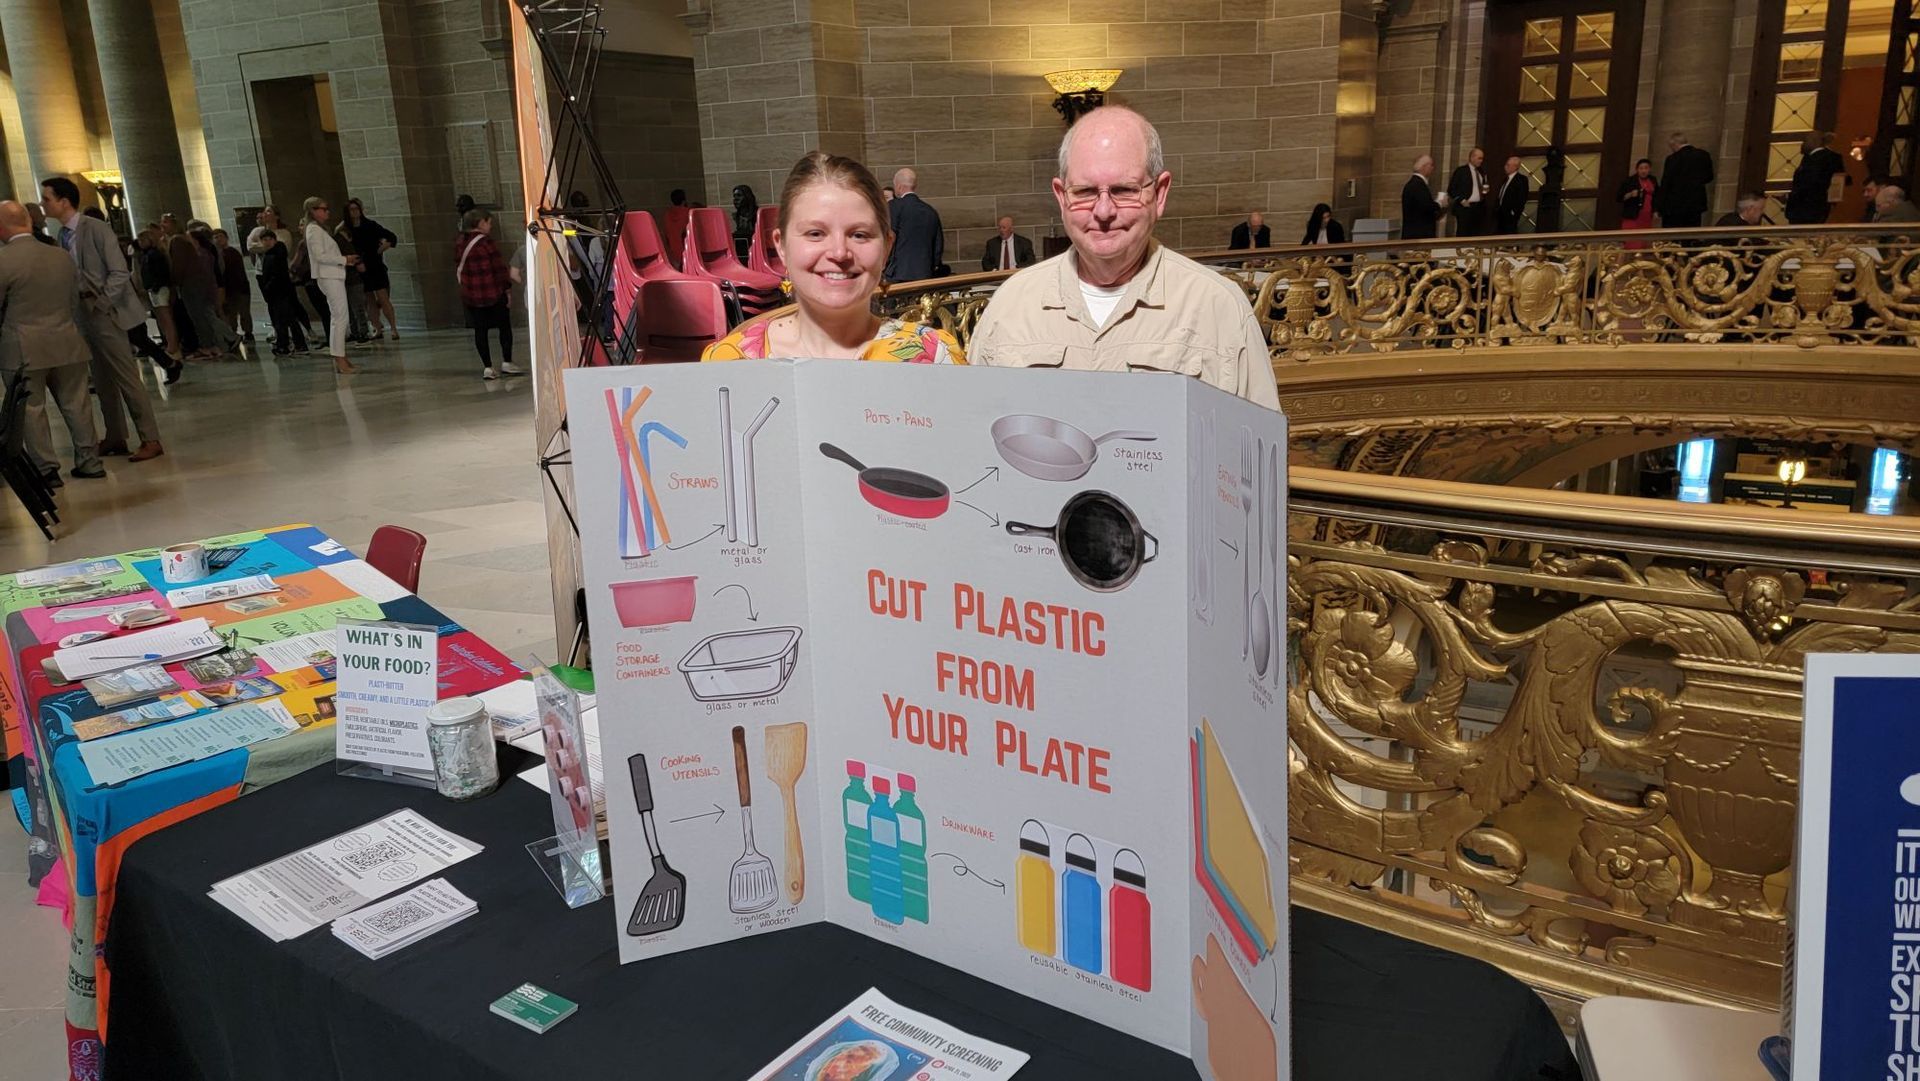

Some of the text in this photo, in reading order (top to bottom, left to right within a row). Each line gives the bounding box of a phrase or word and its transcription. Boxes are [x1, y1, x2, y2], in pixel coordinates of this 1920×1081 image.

[904, 411, 933, 428] PANS
[734, 555, 762, 567] glass
[867, 568, 1106, 656] CUT PLASTIC
[346, 629, 422, 650] WHAT'S IN
[616, 642, 642, 653] FOOD
[343, 654, 380, 671] YOUR
[384, 658, 431, 676] FOOD?
[616, 654, 660, 666] STORAGE
[616, 667, 671, 680] CONTAINERS
[936, 652, 1034, 711] FROM
[706, 702, 732, 715] glass
[753, 696, 780, 708] metal
[882, 693, 1112, 794] YOUR PLATE
[660, 756, 702, 770] COOKING
[672, 766, 720, 782] UTENSILS
[942, 816, 996, 842] DRINKWARE
[1030, 954, 1068, 976] reusable
[860, 1005, 1003, 1073] FREE COMMUNITY SCREENING
